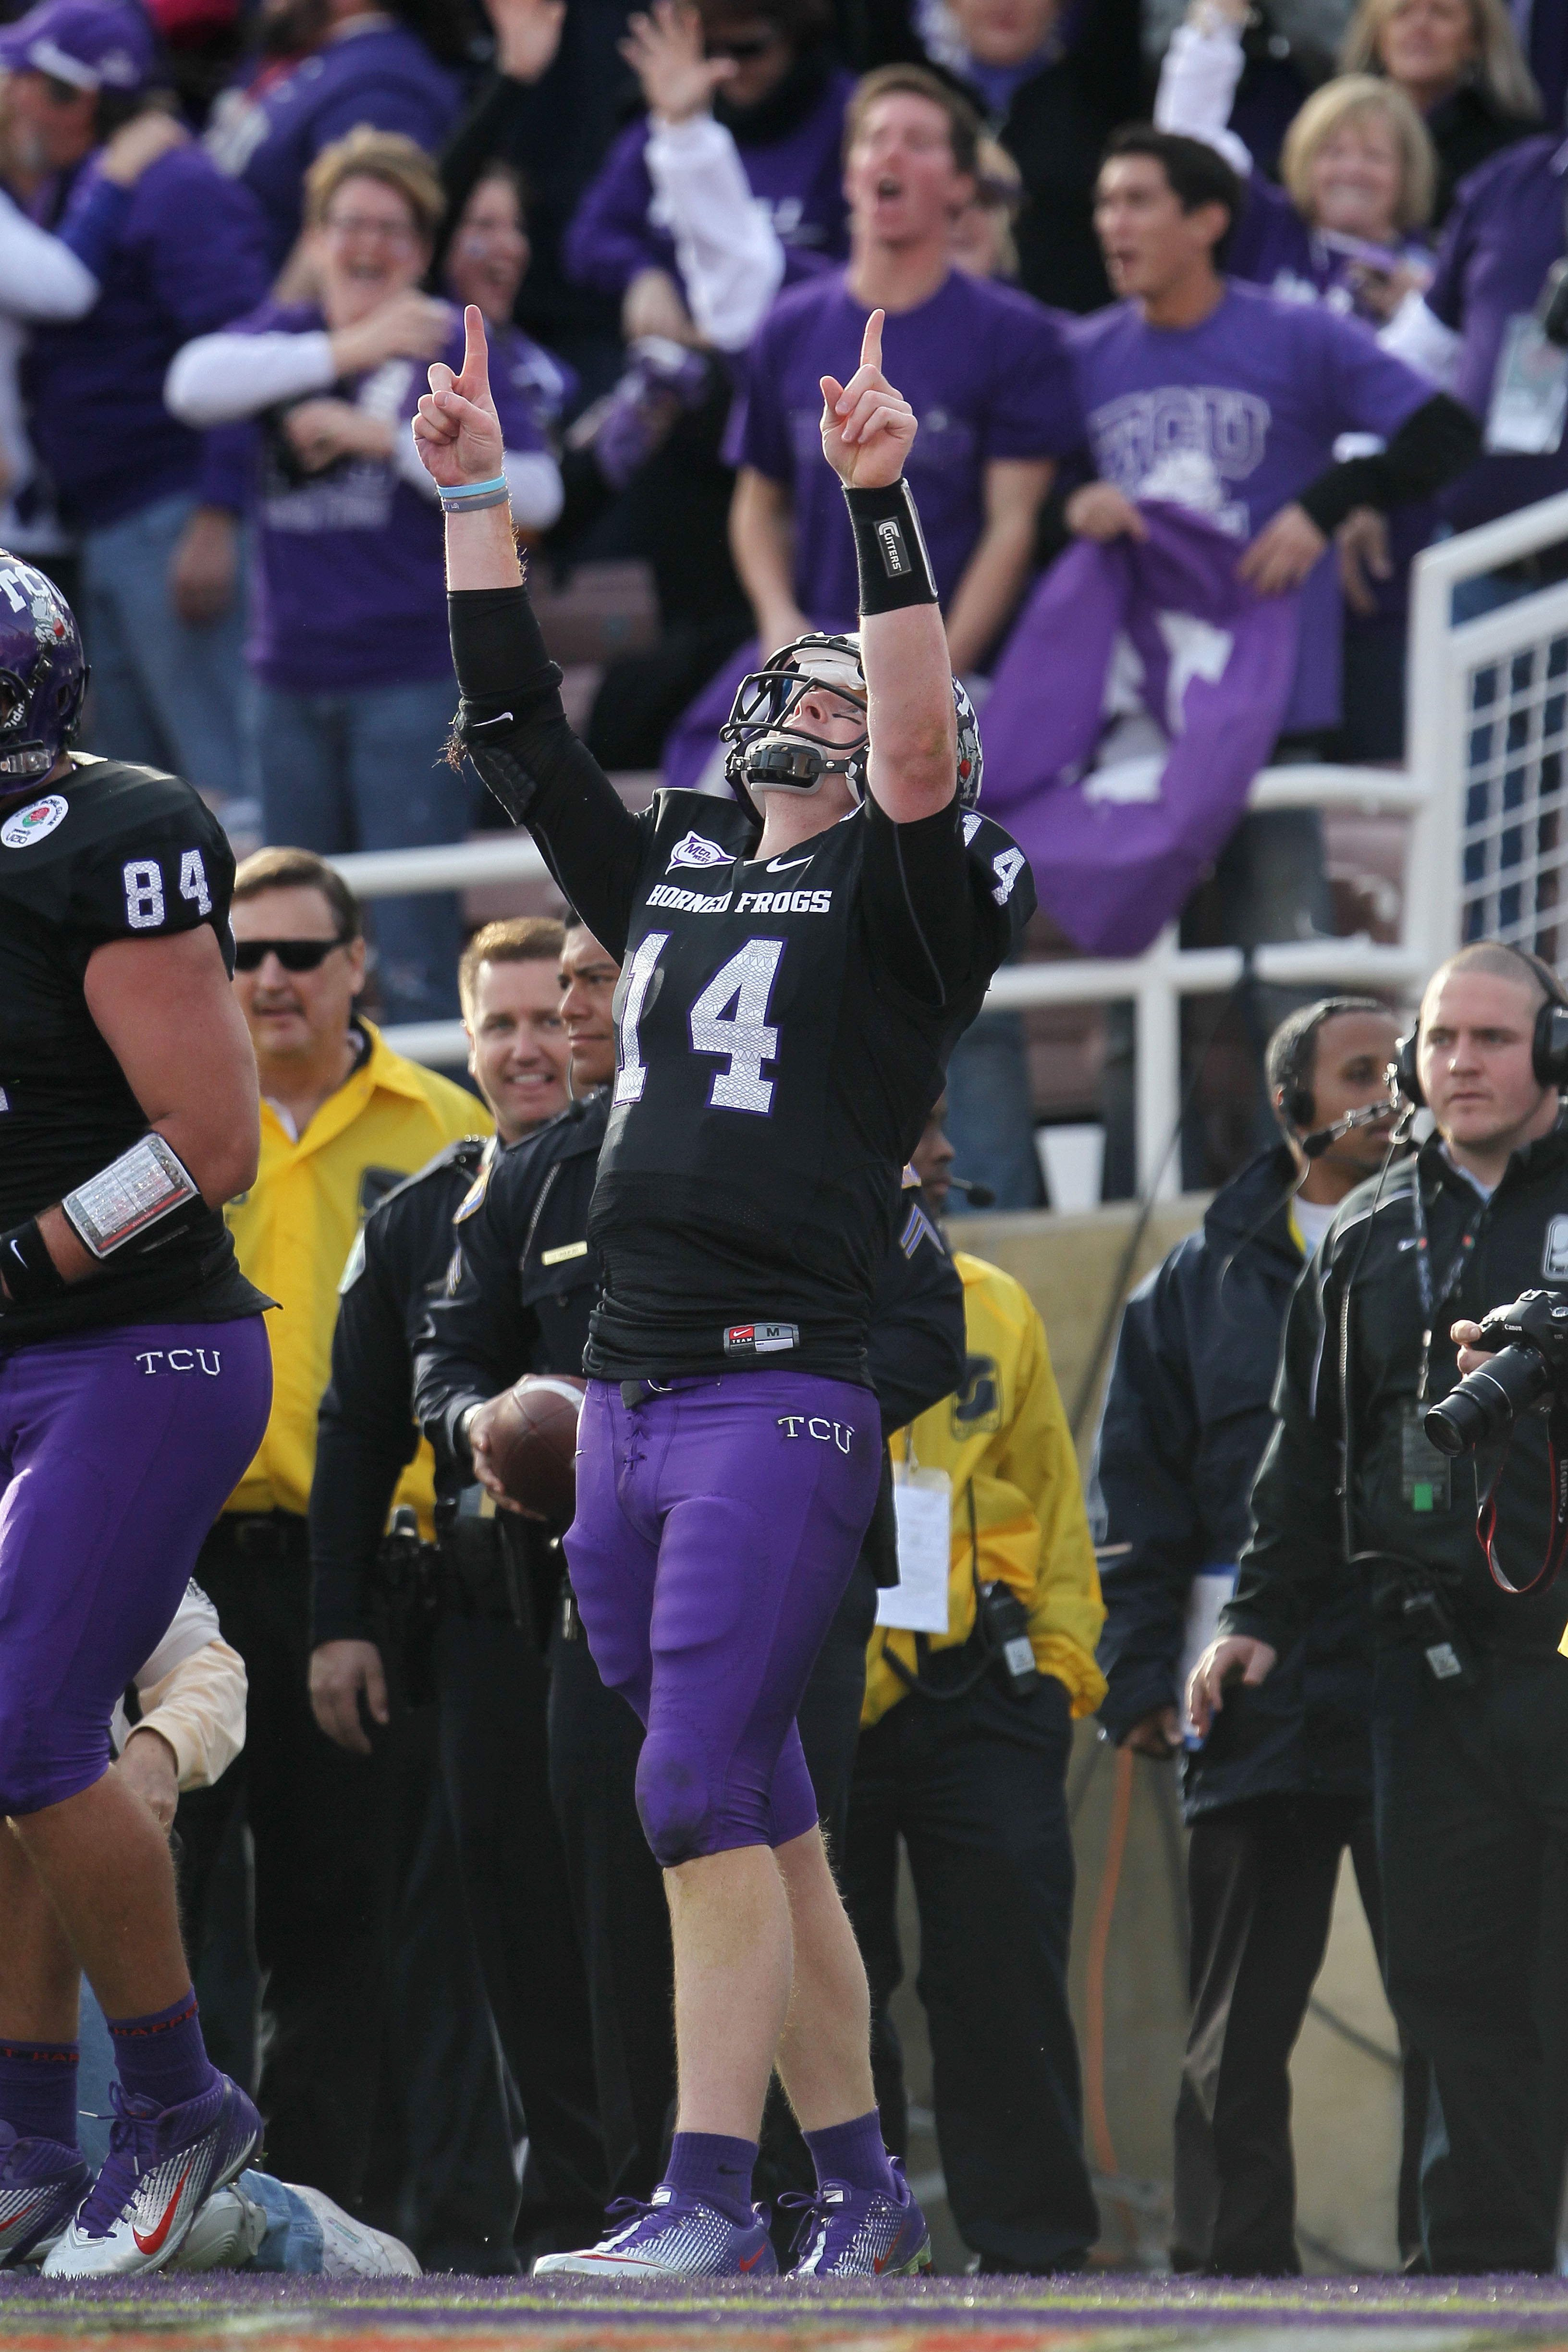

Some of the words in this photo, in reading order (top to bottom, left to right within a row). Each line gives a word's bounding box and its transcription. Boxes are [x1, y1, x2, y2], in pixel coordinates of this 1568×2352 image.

[1087, 387, 1272, 490] TCU
[879, 521, 901, 571] CUTTERS
[6, 833, 28, 844] VIZIO
[684, 843, 711, 859] Mtn.
[692, 854, 710, 864] WEST
[123, 849, 213, 929] 84
[645, 883, 734, 914] HORNED
[734, 890, 833, 914] FROGS
[613, 930, 788, 1116] 14
[766, 1327, 780, 1337] M
[135, 1348, 220, 1376] TCU
[777, 1416, 852, 1454] TCU
